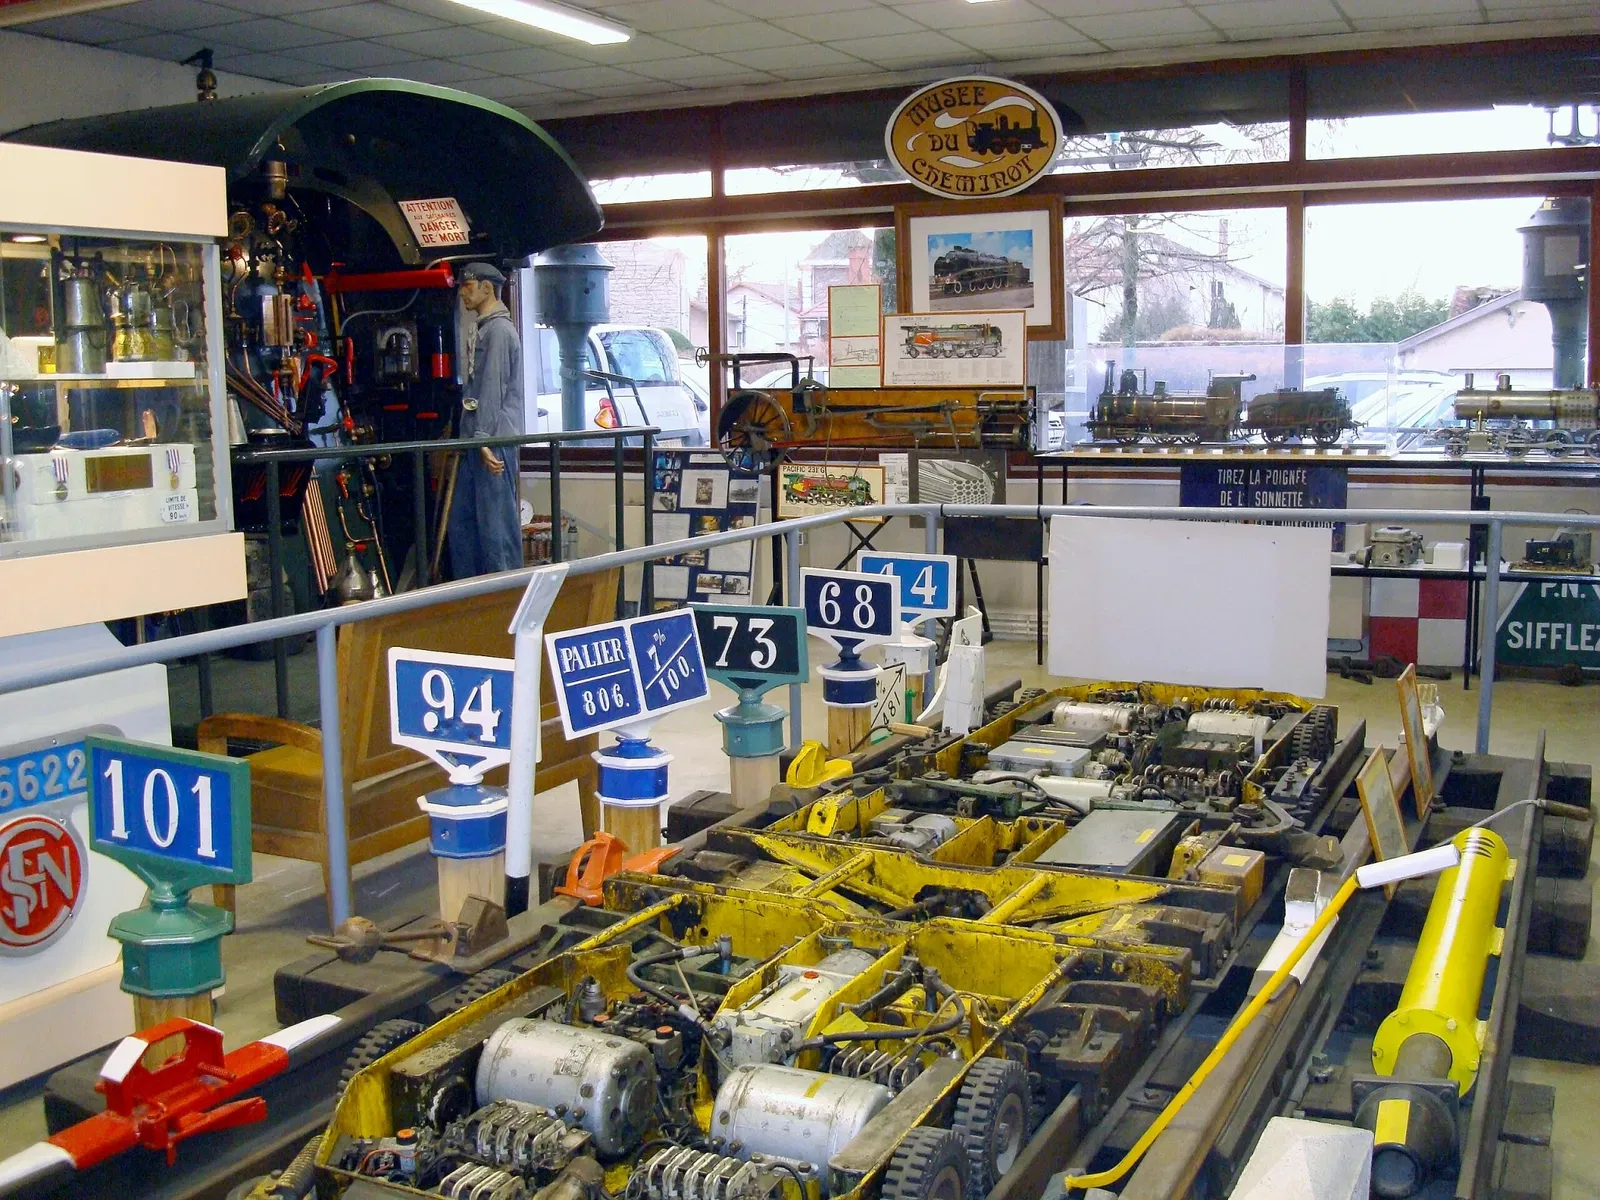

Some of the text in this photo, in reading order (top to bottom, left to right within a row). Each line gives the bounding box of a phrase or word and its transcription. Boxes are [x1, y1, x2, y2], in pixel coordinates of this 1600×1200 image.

[906, 86, 987, 127] MUSEE
[928, 133, 959, 152] DU
[912, 155, 1034, 192] CHEMINOT
[407, 201, 454, 212] ATTENTION
[420, 220, 460, 232] DANGER
[422, 232, 467, 243] DE MORT
[1217, 469, 1245, 485] TIREZ
[1249, 469, 1261, 485] LA
[168, 503, 185, 511] VITESSE
[1220, 491, 1232, 506] DE
[1255, 491, 1303, 507] SONNETTE
[169, 511, 178, 520] 90
[819, 581, 876, 629] 68
[713, 616, 777, 669] 73
[560, 638, 626, 673] PALIER
[422, 669, 501, 742] 94
[104, 759, 218, 858] 101
